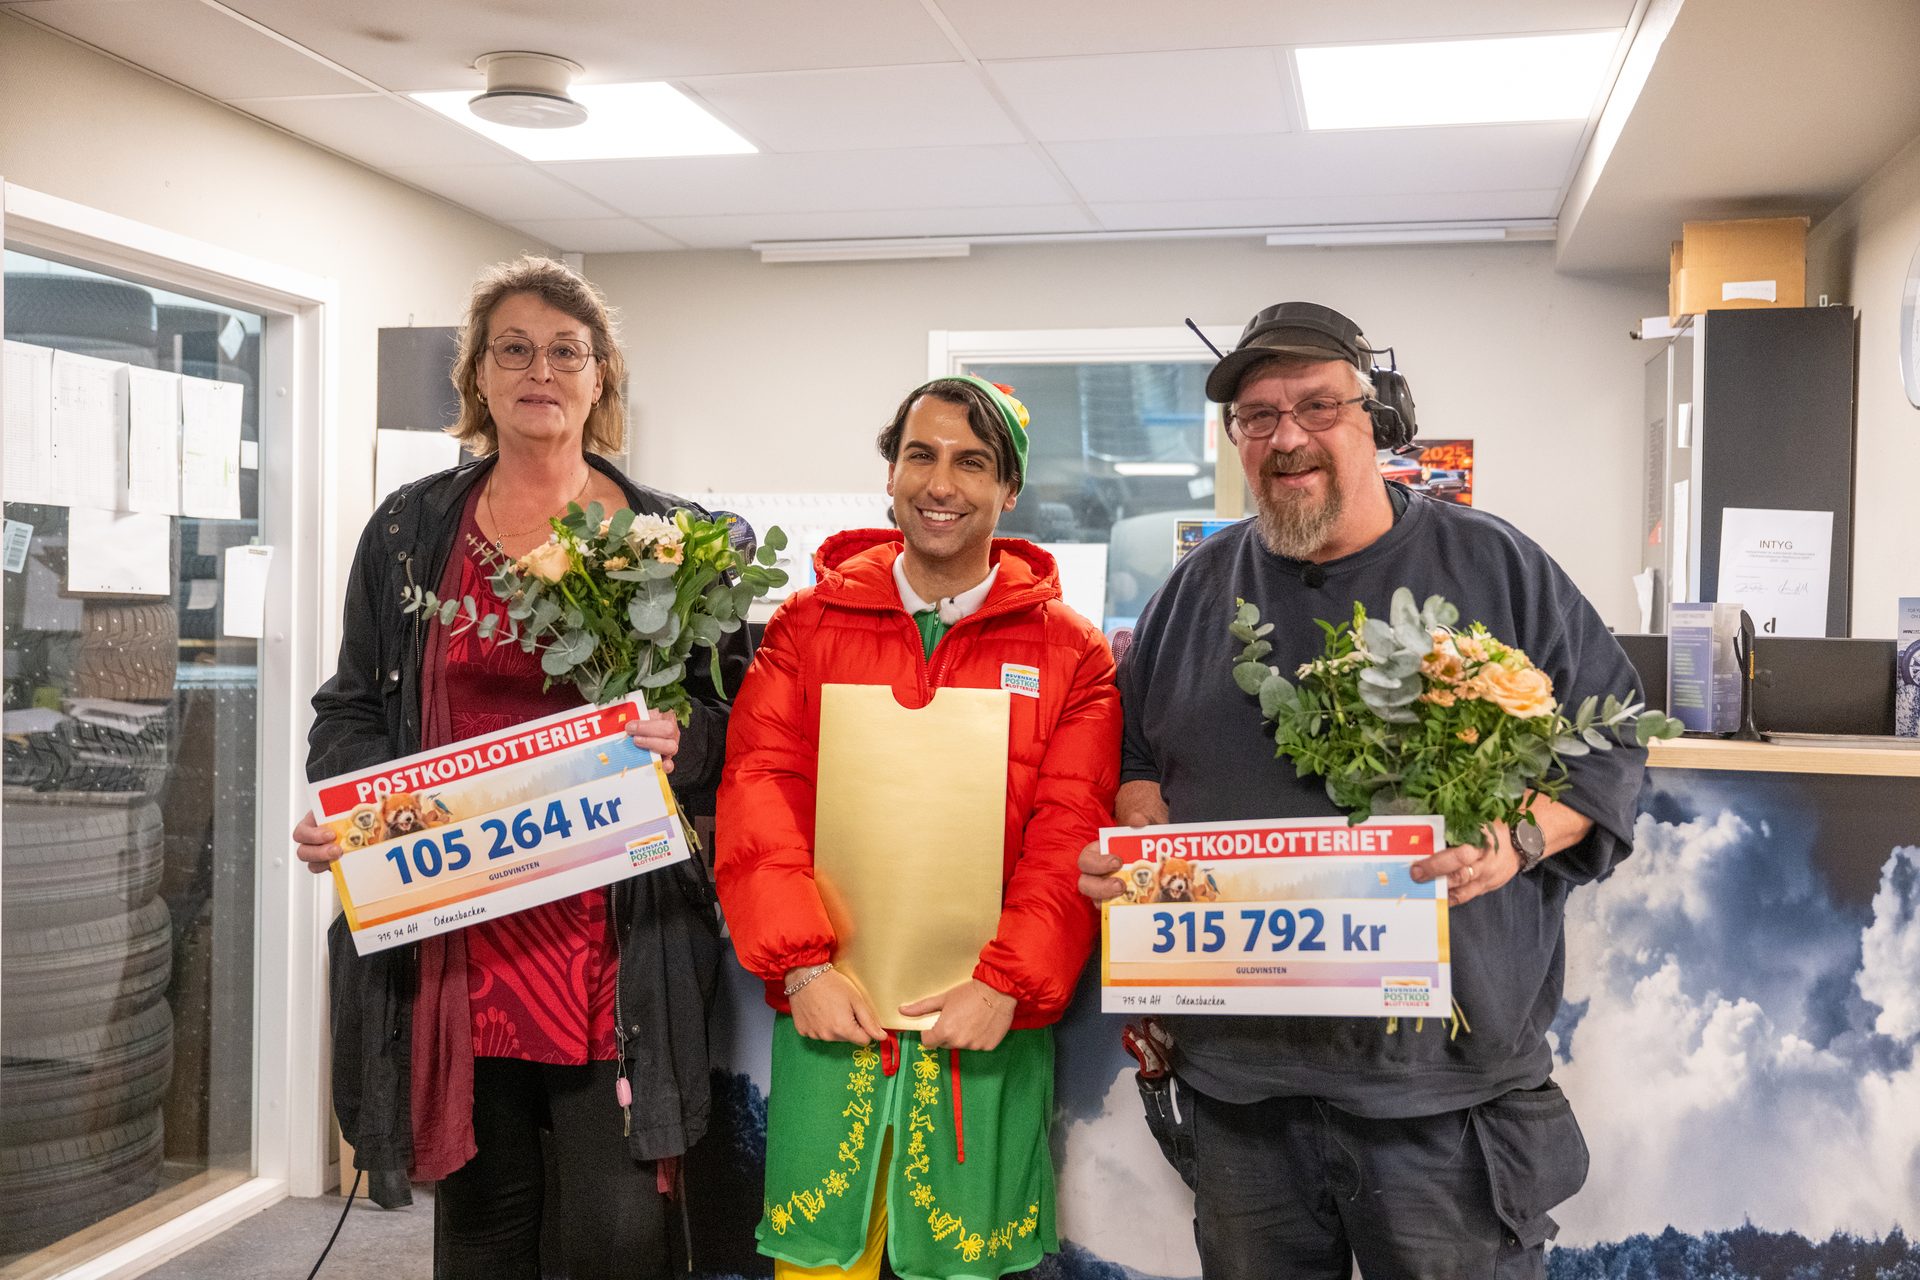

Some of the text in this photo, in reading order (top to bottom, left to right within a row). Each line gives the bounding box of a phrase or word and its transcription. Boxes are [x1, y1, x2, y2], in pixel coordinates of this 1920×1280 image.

[1759, 540, 1793, 550] INTYG
[1010, 674, 1036, 682] SVENSKA
[1009, 684, 1036, 692] LOTTERIET
[356, 715, 602, 803] POSTKODLOTTERIET
[385, 796, 622, 885] 105 264 kr
[634, 841, 664, 854] SVENSKA
[1141, 829, 1393, 859] POSTKODLOTTERIET
[631, 845, 670, 862] POSTKOD
[637, 852, 667, 866] LOTTERIET
[489, 861, 540, 881] GULDVINSTEN
[377, 905, 487, 943] 715 94 AH Odensbacken
[1152, 908, 1387, 953] 315 792 kr
[1235, 966, 1287, 974] GULDVINSTEN
[1122, 994, 1226, 1006] 715 94 AH Odensbacken
[1383, 993, 1430, 1001] POSTKOD
